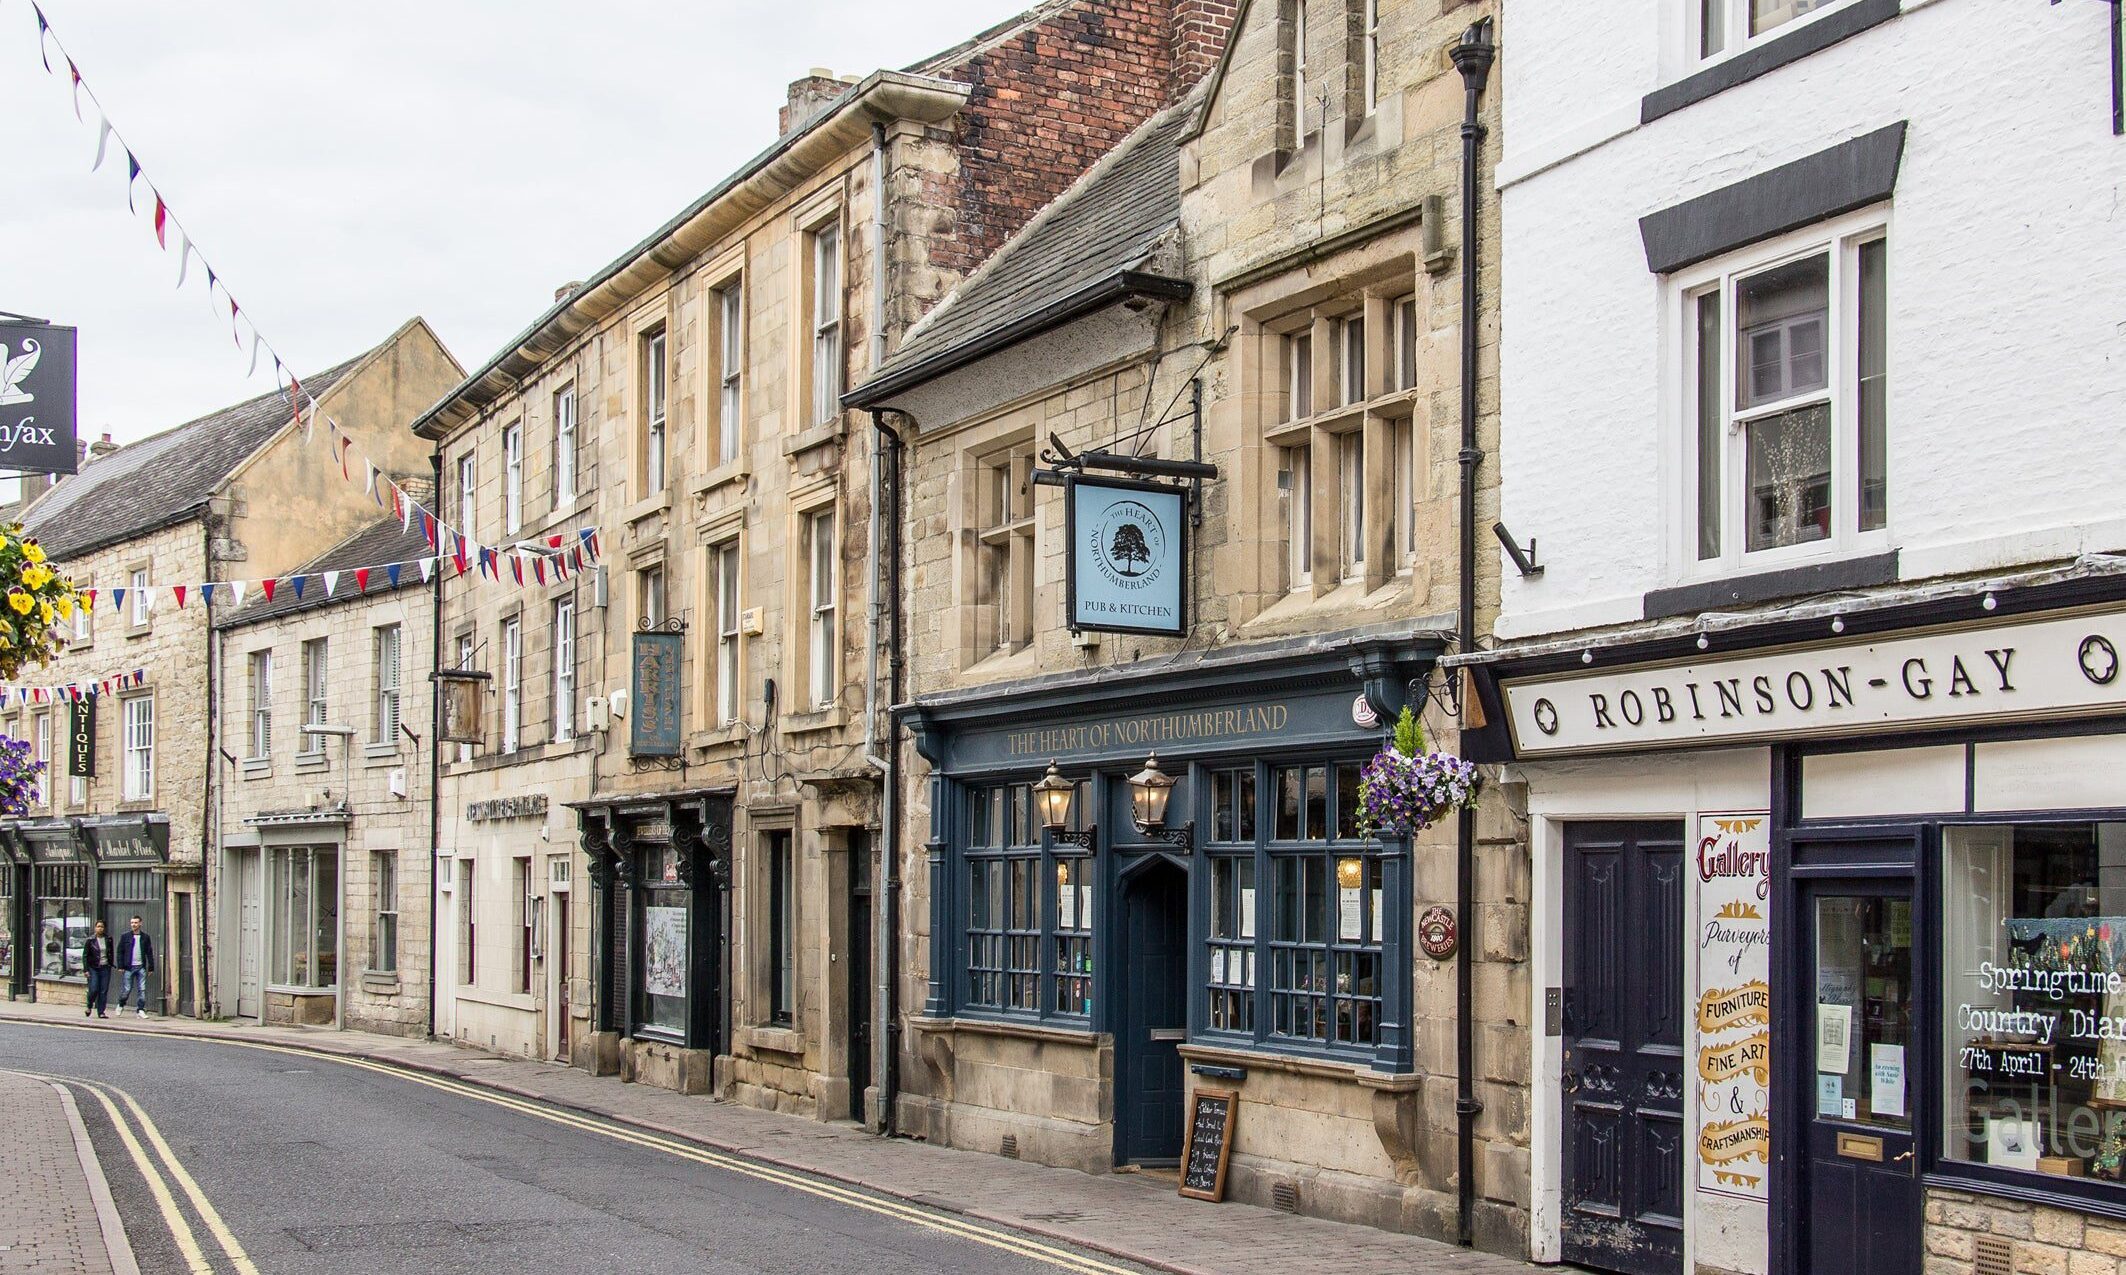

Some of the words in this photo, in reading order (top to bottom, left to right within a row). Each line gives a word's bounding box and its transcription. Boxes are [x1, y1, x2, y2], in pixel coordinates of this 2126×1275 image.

[1125, 508, 1158, 534] HEART
[1090, 529, 1160, 590] NORTHUMBERLAND
[1085, 601, 1106, 612] PUB
[1109, 603, 1117, 613] &
[1120, 604, 1172, 617] KITCHEN
[1589, 648, 2016, 728] ROBINSON-GAY
[76, 694, 89, 772] ANTIQUES
[1008, 733, 1037, 755] THE
[1040, 727, 1087, 751] HEART
[1089, 724, 1112, 747] OF
[1114, 705, 1288, 744] NORTHUMBERLAND
[1697, 834, 1770, 900] Gallery
[1421, 914, 1455, 930] NEWCASTLE
[1421, 935, 1454, 952] BREWERIES
[1728, 949, 1742, 974] of
[1980, 961, 2121, 1000] Springtime
[1706, 991, 1768, 1018] FURNITURE
[1958, 1004, 2055, 1045] Country
[1707, 1053, 1737, 1071] FINE
[1740, 1044, 1767, 1063] ART
[1959, 1047, 1992, 1071] 27th
[2000, 1051, 2044, 1077] April
[2069, 1056, 2105, 1079] 24th
[1730, 1086, 1744, 1114] &
[1701, 1127, 1769, 1151] CRAFTSMANSHIP
